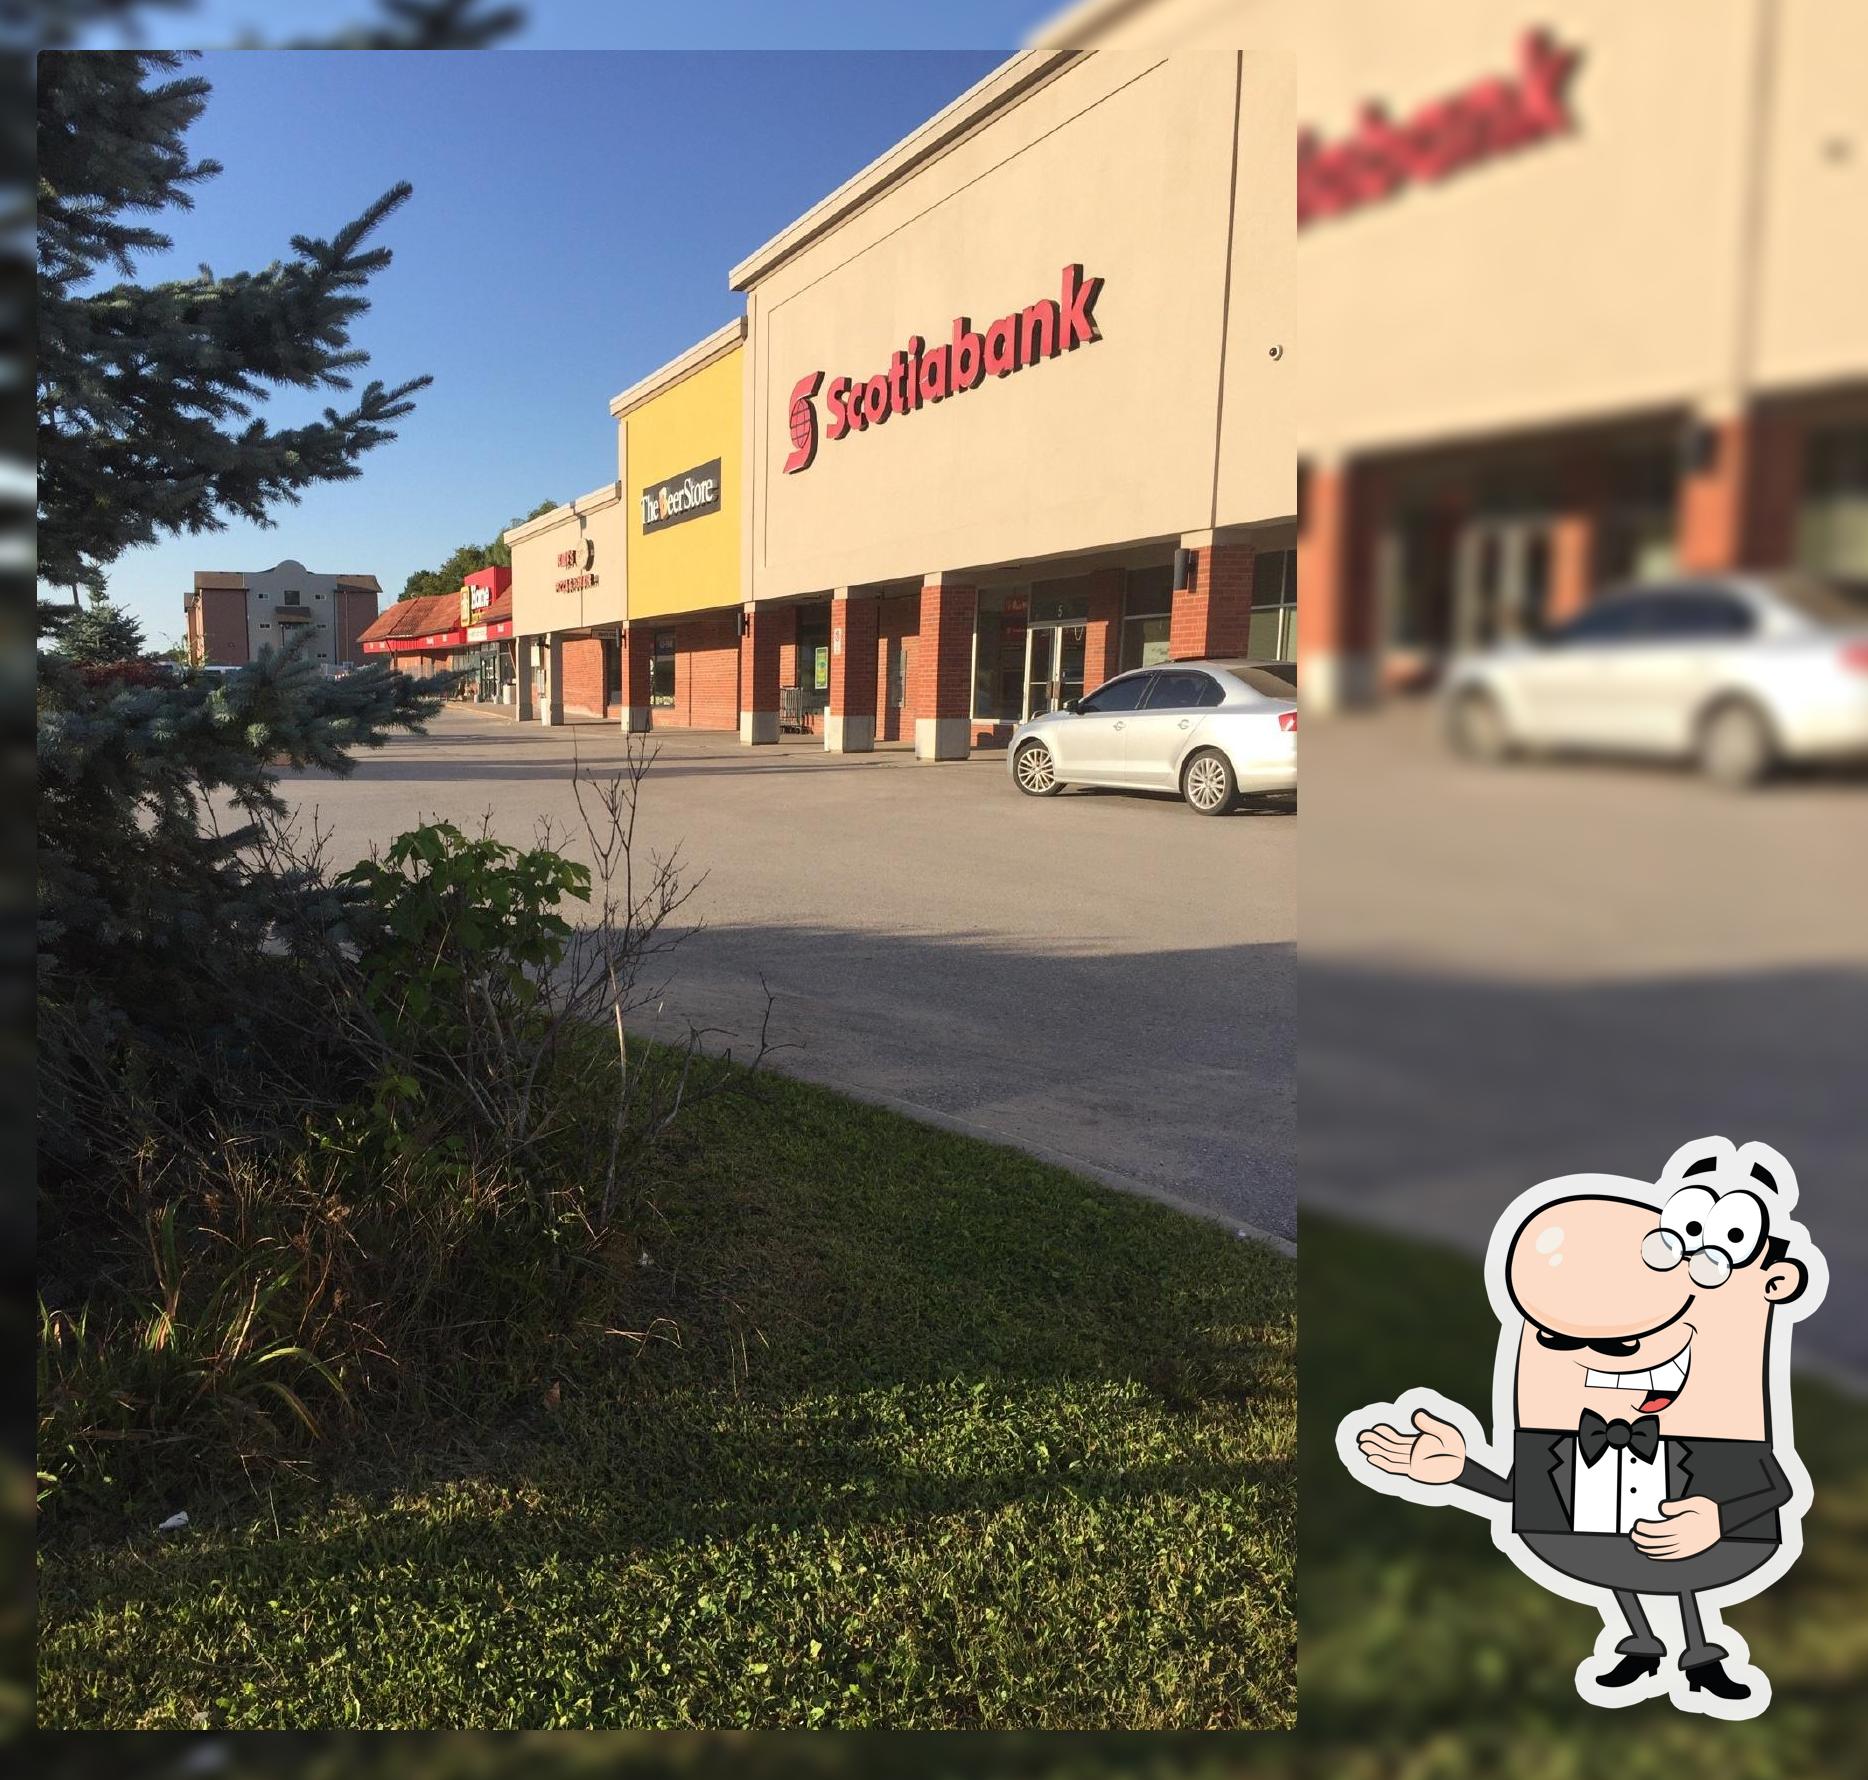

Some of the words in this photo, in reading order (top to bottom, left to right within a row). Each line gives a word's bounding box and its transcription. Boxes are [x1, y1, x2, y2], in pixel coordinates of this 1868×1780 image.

[827, 264, 1104, 440] Scotiabank
[641, 495, 659, 524] The
[658, 486, 684, 520] Beer
[684, 477, 714, 509] Store
[1057, 604, 1064, 618] 5
